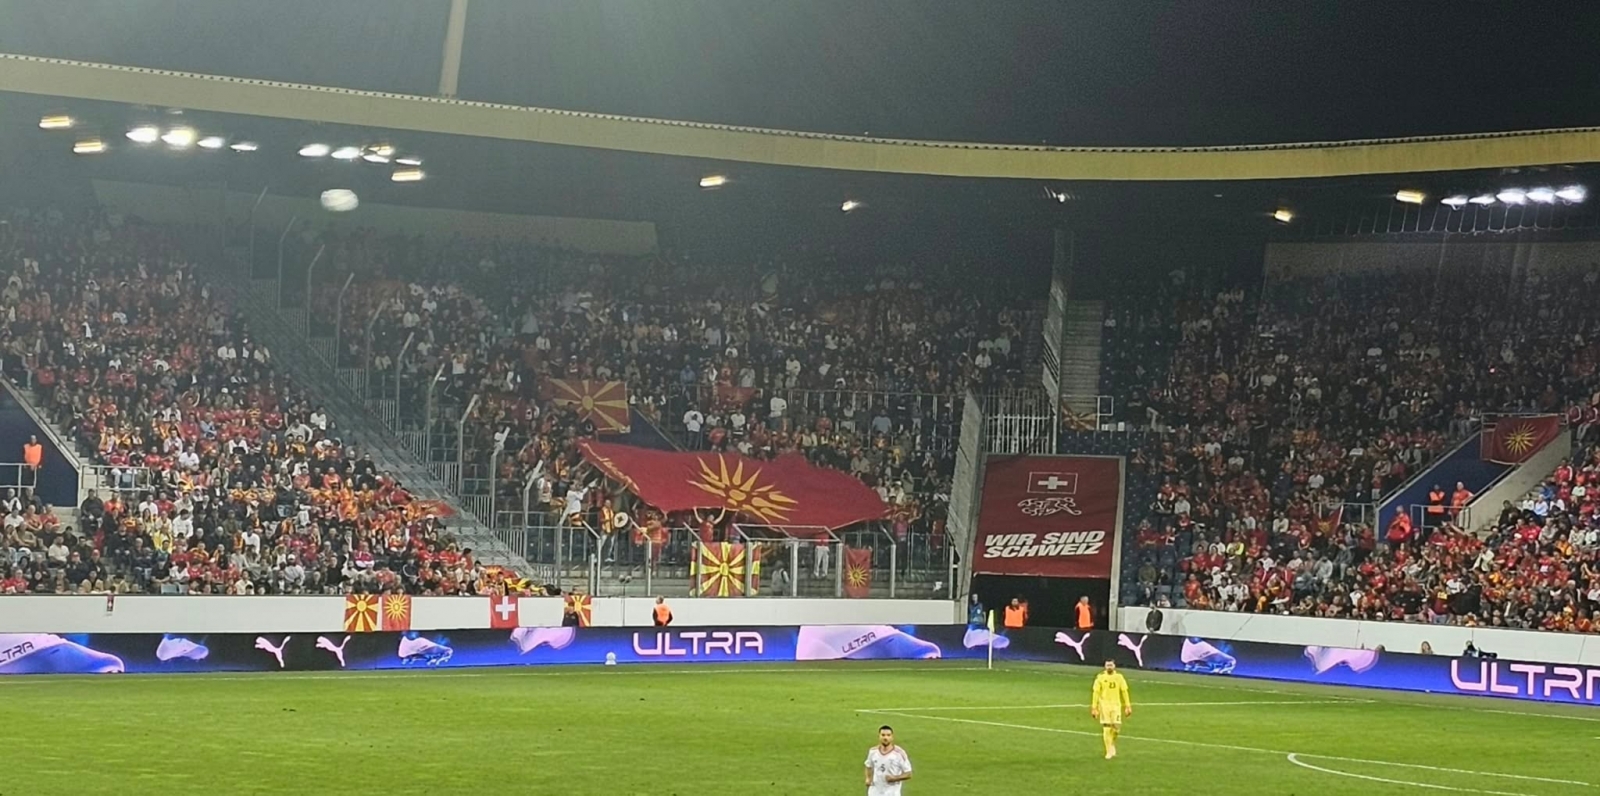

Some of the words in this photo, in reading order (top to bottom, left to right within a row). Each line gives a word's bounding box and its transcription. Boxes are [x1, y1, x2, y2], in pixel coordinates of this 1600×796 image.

[985, 533, 1037, 546] WIR
[1041, 530, 1106, 545] SIND
[983, 542, 1104, 558] SCHWEIZ
[633, 631, 763, 655] ULTRA
[841, 631, 877, 653] ULTRA
